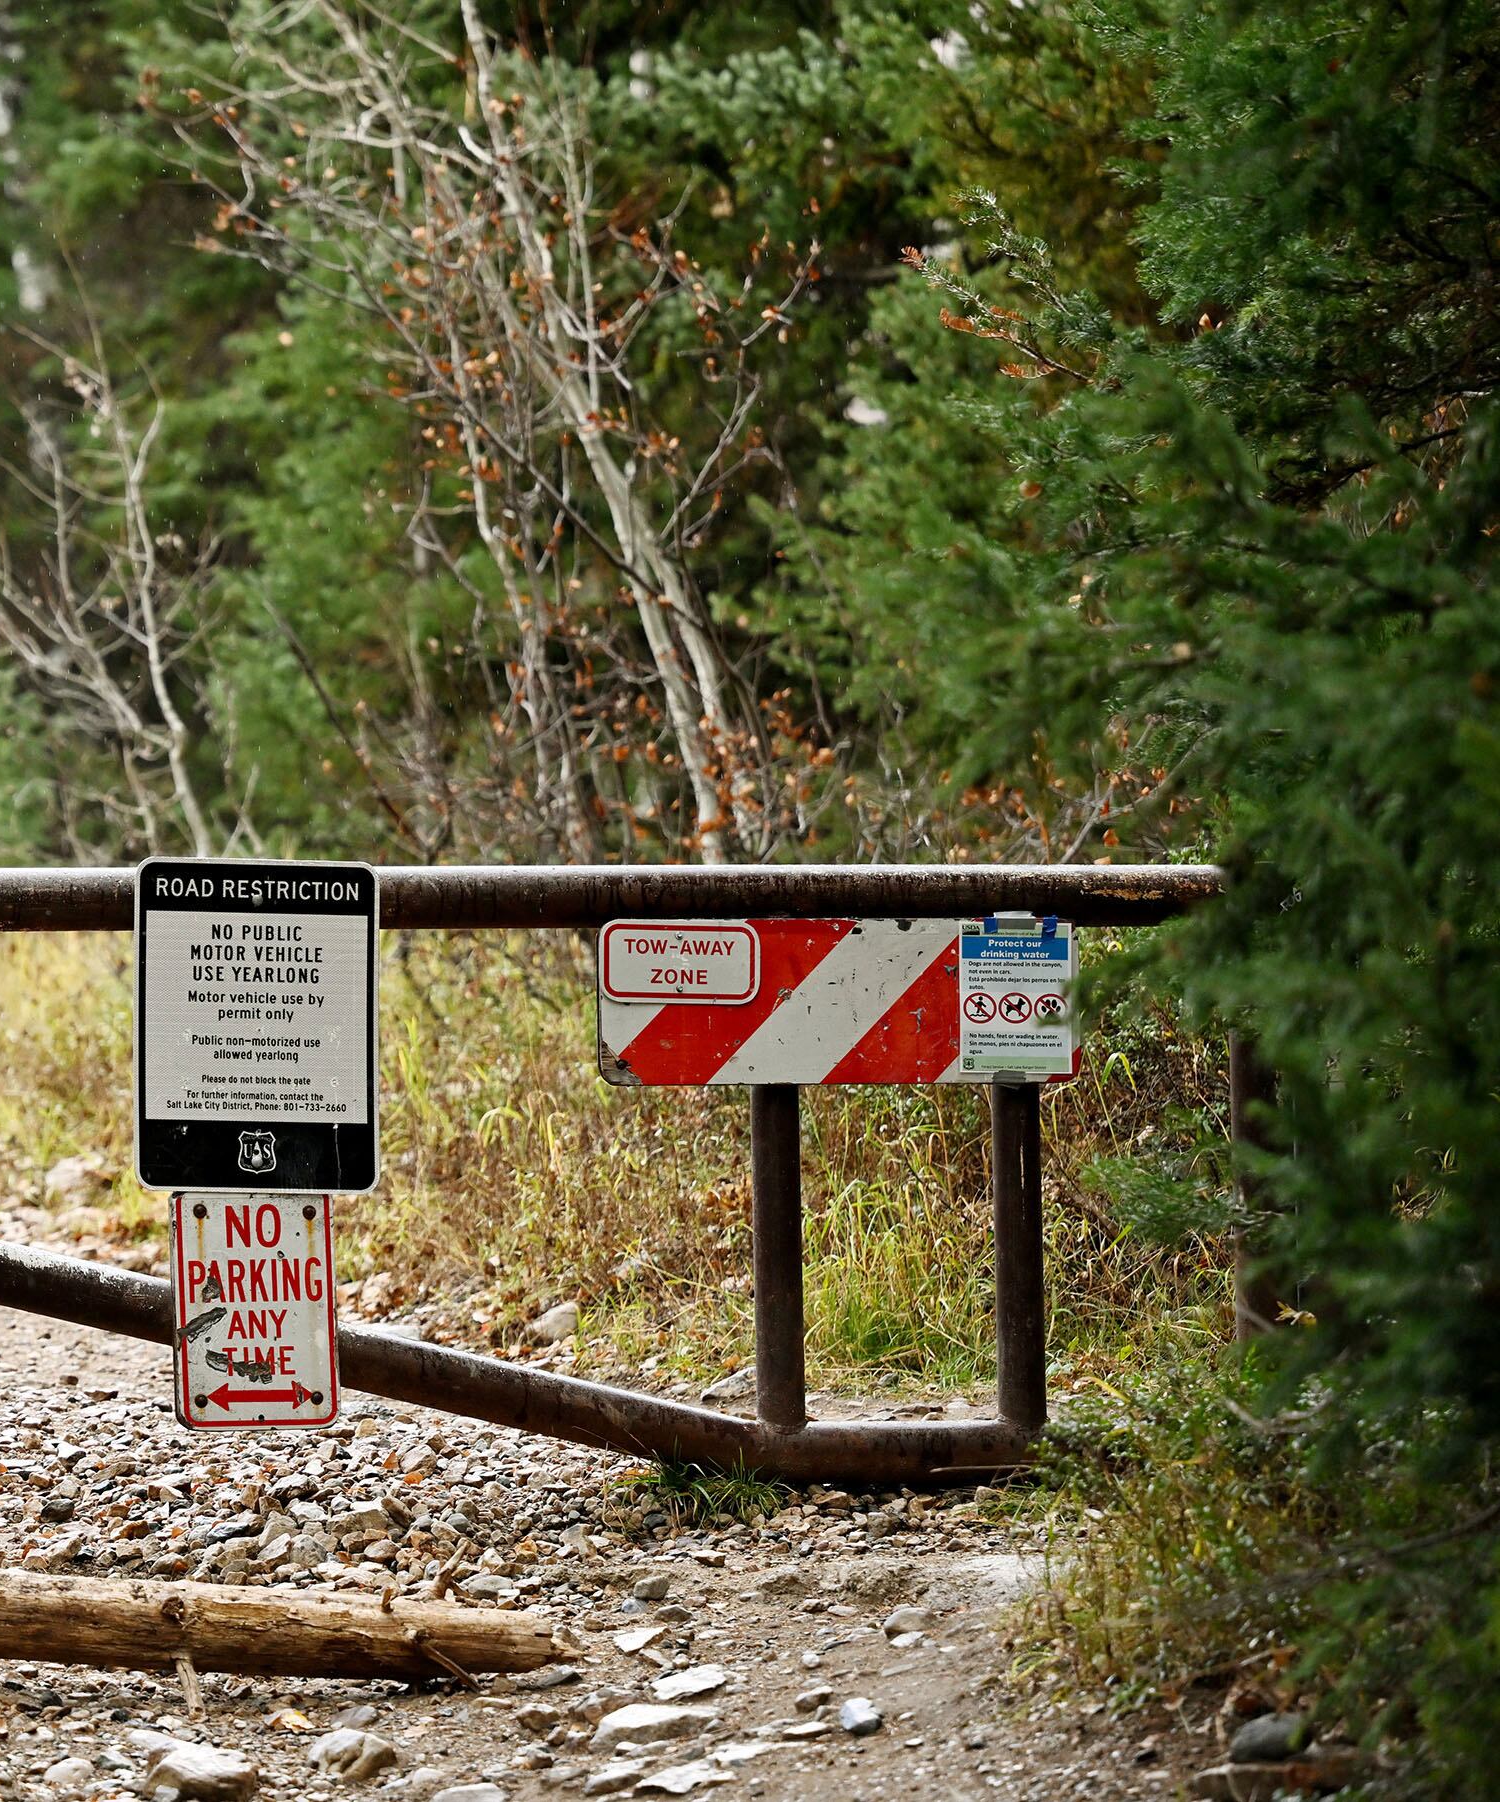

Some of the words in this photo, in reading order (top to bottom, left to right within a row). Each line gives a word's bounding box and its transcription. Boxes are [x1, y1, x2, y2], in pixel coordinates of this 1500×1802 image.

[155, 877, 214, 898] ROAD
[222, 879, 359, 901] RESTRICTION
[211, 924, 233, 940] NO
[242, 925, 303, 941] PUBLIC
[624, 938, 735, 956] TOW-AWAY
[988, 939, 1024, 947] Protect
[190, 944, 246, 961] MOTOR
[254, 946, 323, 963] VEHICLE
[980, 949, 1019, 960] drinking
[1021, 951, 1050, 959] water
[192, 965, 225, 982] USE
[231, 966, 320, 984] YEARLONG
[650, 968, 708, 985] ZONE
[188, 990, 226, 1003] Motor
[229, 991, 277, 1004] vehicle
[281, 994, 304, 1005] use
[308, 993, 325, 1008] by
[218, 1008, 261, 1021] permit
[265, 1008, 294, 1023] only
[191, 1034, 223, 1046] Public
[226, 1035, 301, 1047] non-motorized
[303, 1038, 321, 1048] use
[213, 1049, 252, 1060] allowed
[255, 1050, 299, 1063] yearlong
[201, 1074, 226, 1084] Please
[228, 1075, 238, 1084] do
[240, 1075, 253, 1084] not
[255, 1075, 276, 1085] block
[278, 1076, 291, 1085] the
[293, 1077, 311, 1086] gate
[186, 1090, 199, 1099] For
[201, 1090, 229, 1099] further
[230, 1091, 278, 1101] information,
[279, 1092, 308, 1101] contact
[310, 1093, 324, 1102] the
[166, 1100, 181, 1109] Salt
[184, 1100, 202, 1109] Lake
[204, 1100, 220, 1111] City
[222, 1101, 253, 1111] District,
[254, 1102, 282, 1111] Phone:
[283, 1103, 347, 1112] 801-733-2660
[225, 1203, 282, 1249] NO
[188, 1256, 323, 1304] PARKING
[227, 1309, 287, 1340] ANY
